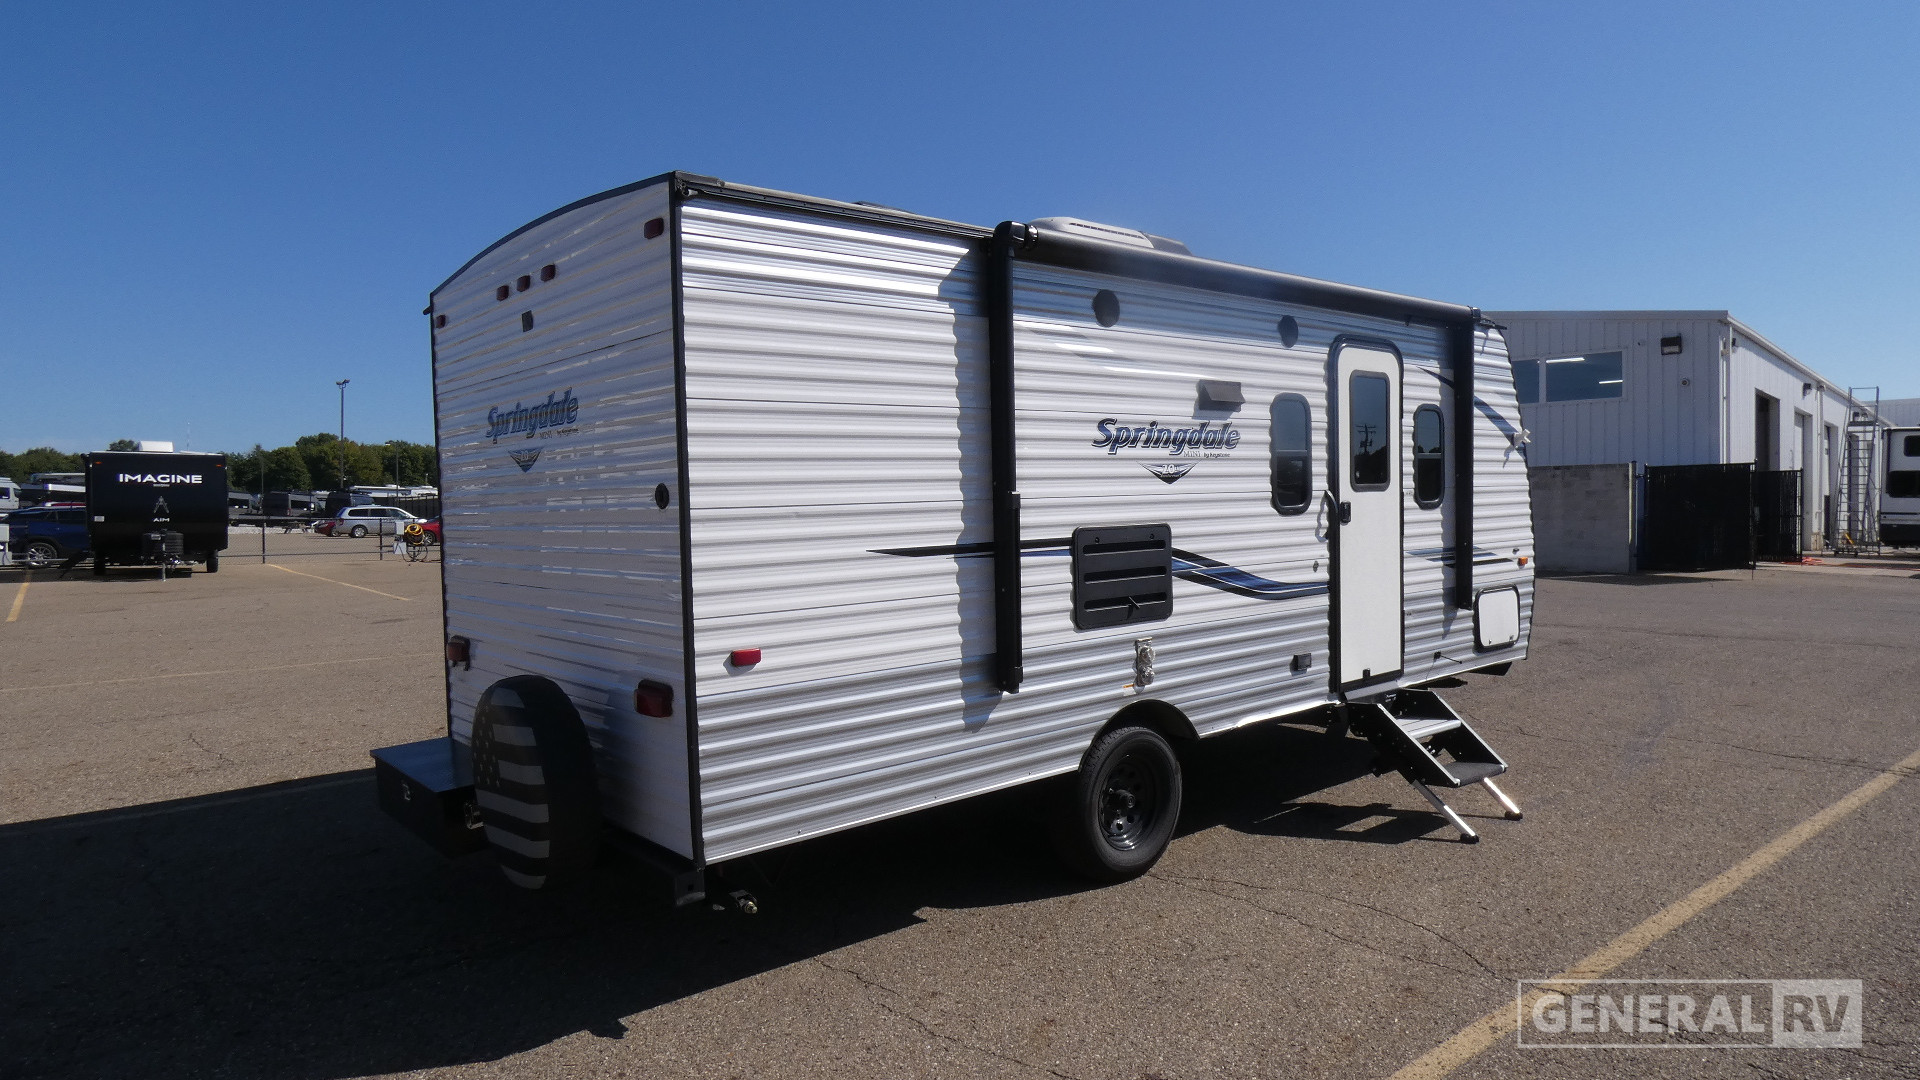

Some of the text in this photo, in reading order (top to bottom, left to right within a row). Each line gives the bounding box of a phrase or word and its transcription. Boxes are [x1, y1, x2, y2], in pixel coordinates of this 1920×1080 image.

[485, 387, 579, 444] Springdale
[1091, 418, 1241, 456] Springdale
[118, 473, 203, 484] IMAGINE
